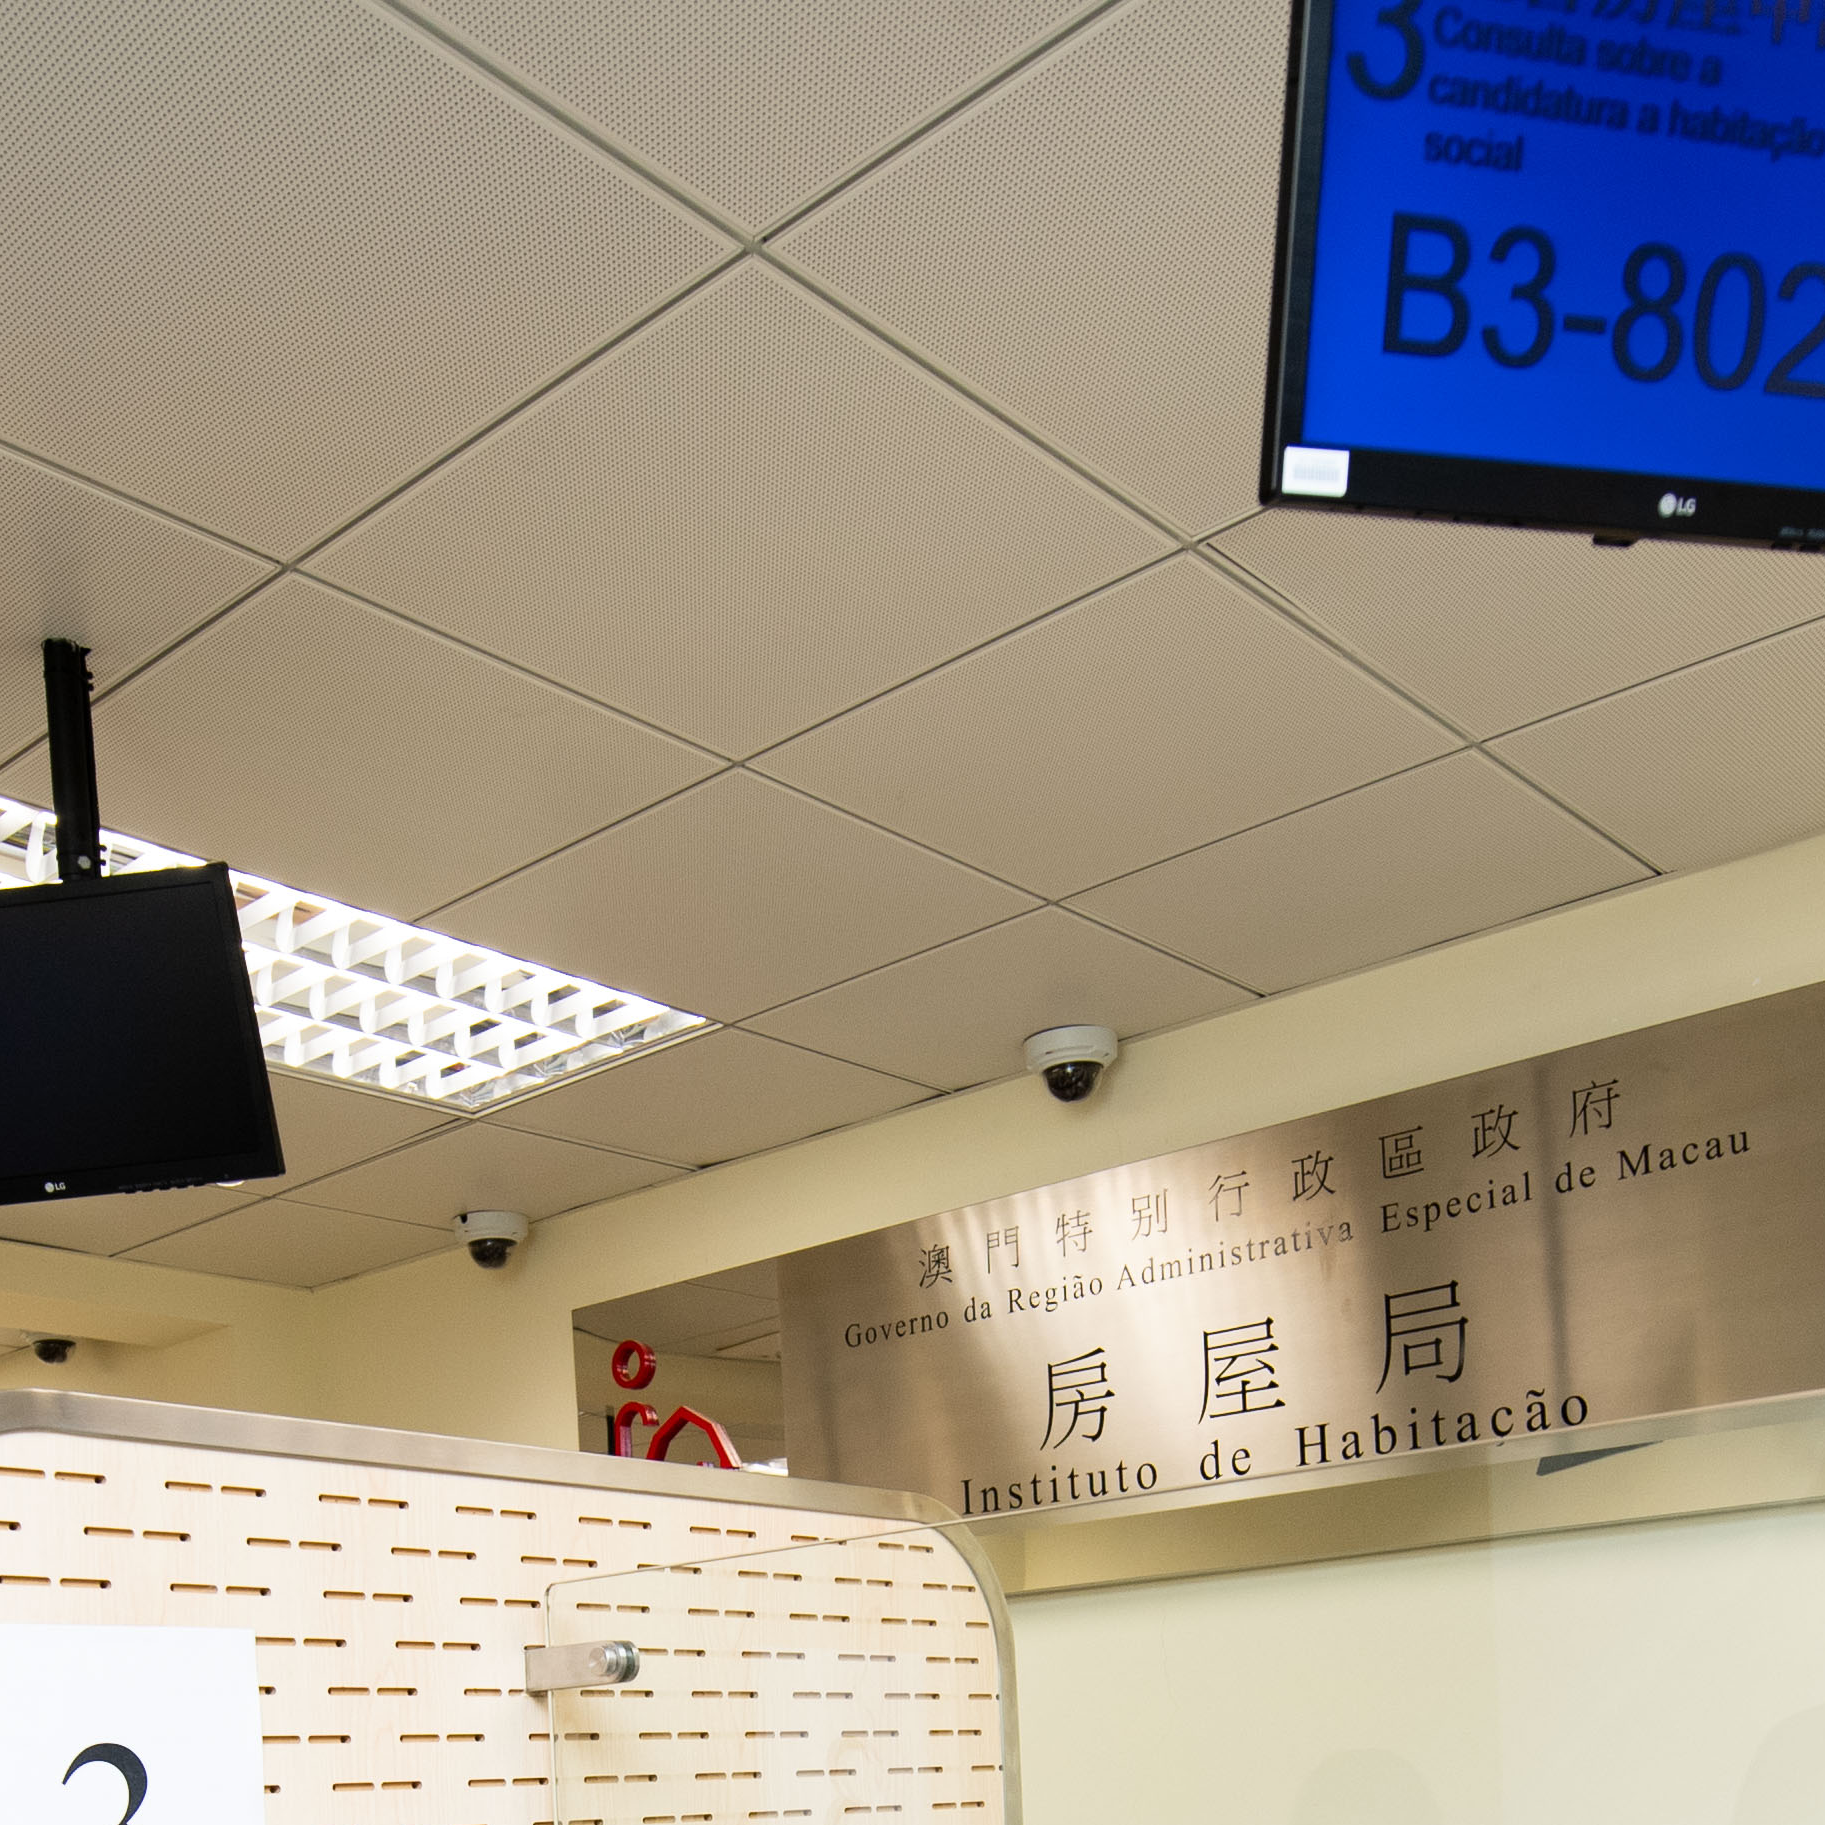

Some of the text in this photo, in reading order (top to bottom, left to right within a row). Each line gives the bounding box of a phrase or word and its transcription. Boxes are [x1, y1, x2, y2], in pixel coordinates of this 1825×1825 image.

[1433, 5, 1587, 67] Consulta
[1596, 37, 1692, 86] sobre
[1700, 57, 1723, 88] a
[1428, 71, 1628, 134] candidatura
[1636, 106, 1658, 136] a
[1425, 130, 1524, 174] social
[1676, 496, 1697, 517] LG
[844, 1129, 1752, 1349] Governo da Região Administrativa Especial de Macau
[1039, 1279, 1469, 1452] 房屋局
[960, 1388, 1589, 1516] Instituto de Habitação
